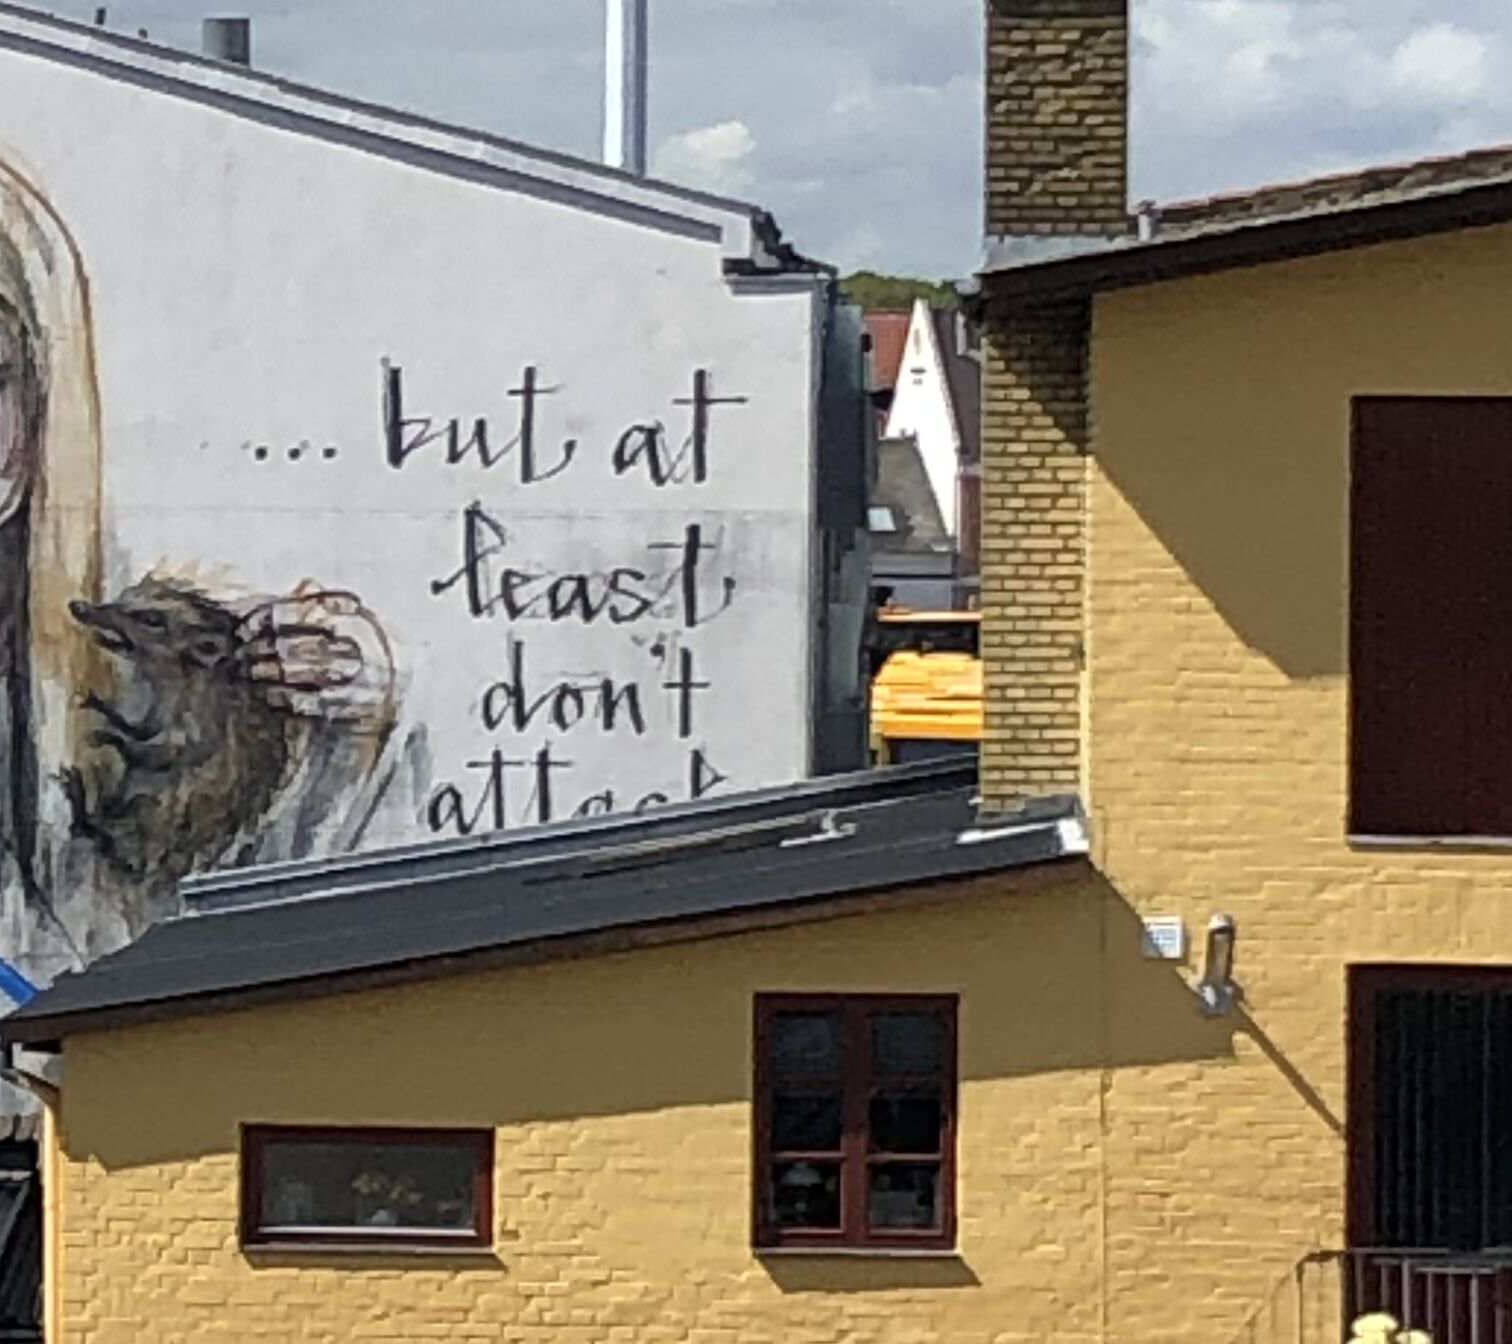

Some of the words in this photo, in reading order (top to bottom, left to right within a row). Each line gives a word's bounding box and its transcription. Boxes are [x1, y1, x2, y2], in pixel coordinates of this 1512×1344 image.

[382, 356, 577, 483] but
[614, 368, 748, 486] at
[431, 501, 736, 629] least
[481, 634, 711, 739] don't
